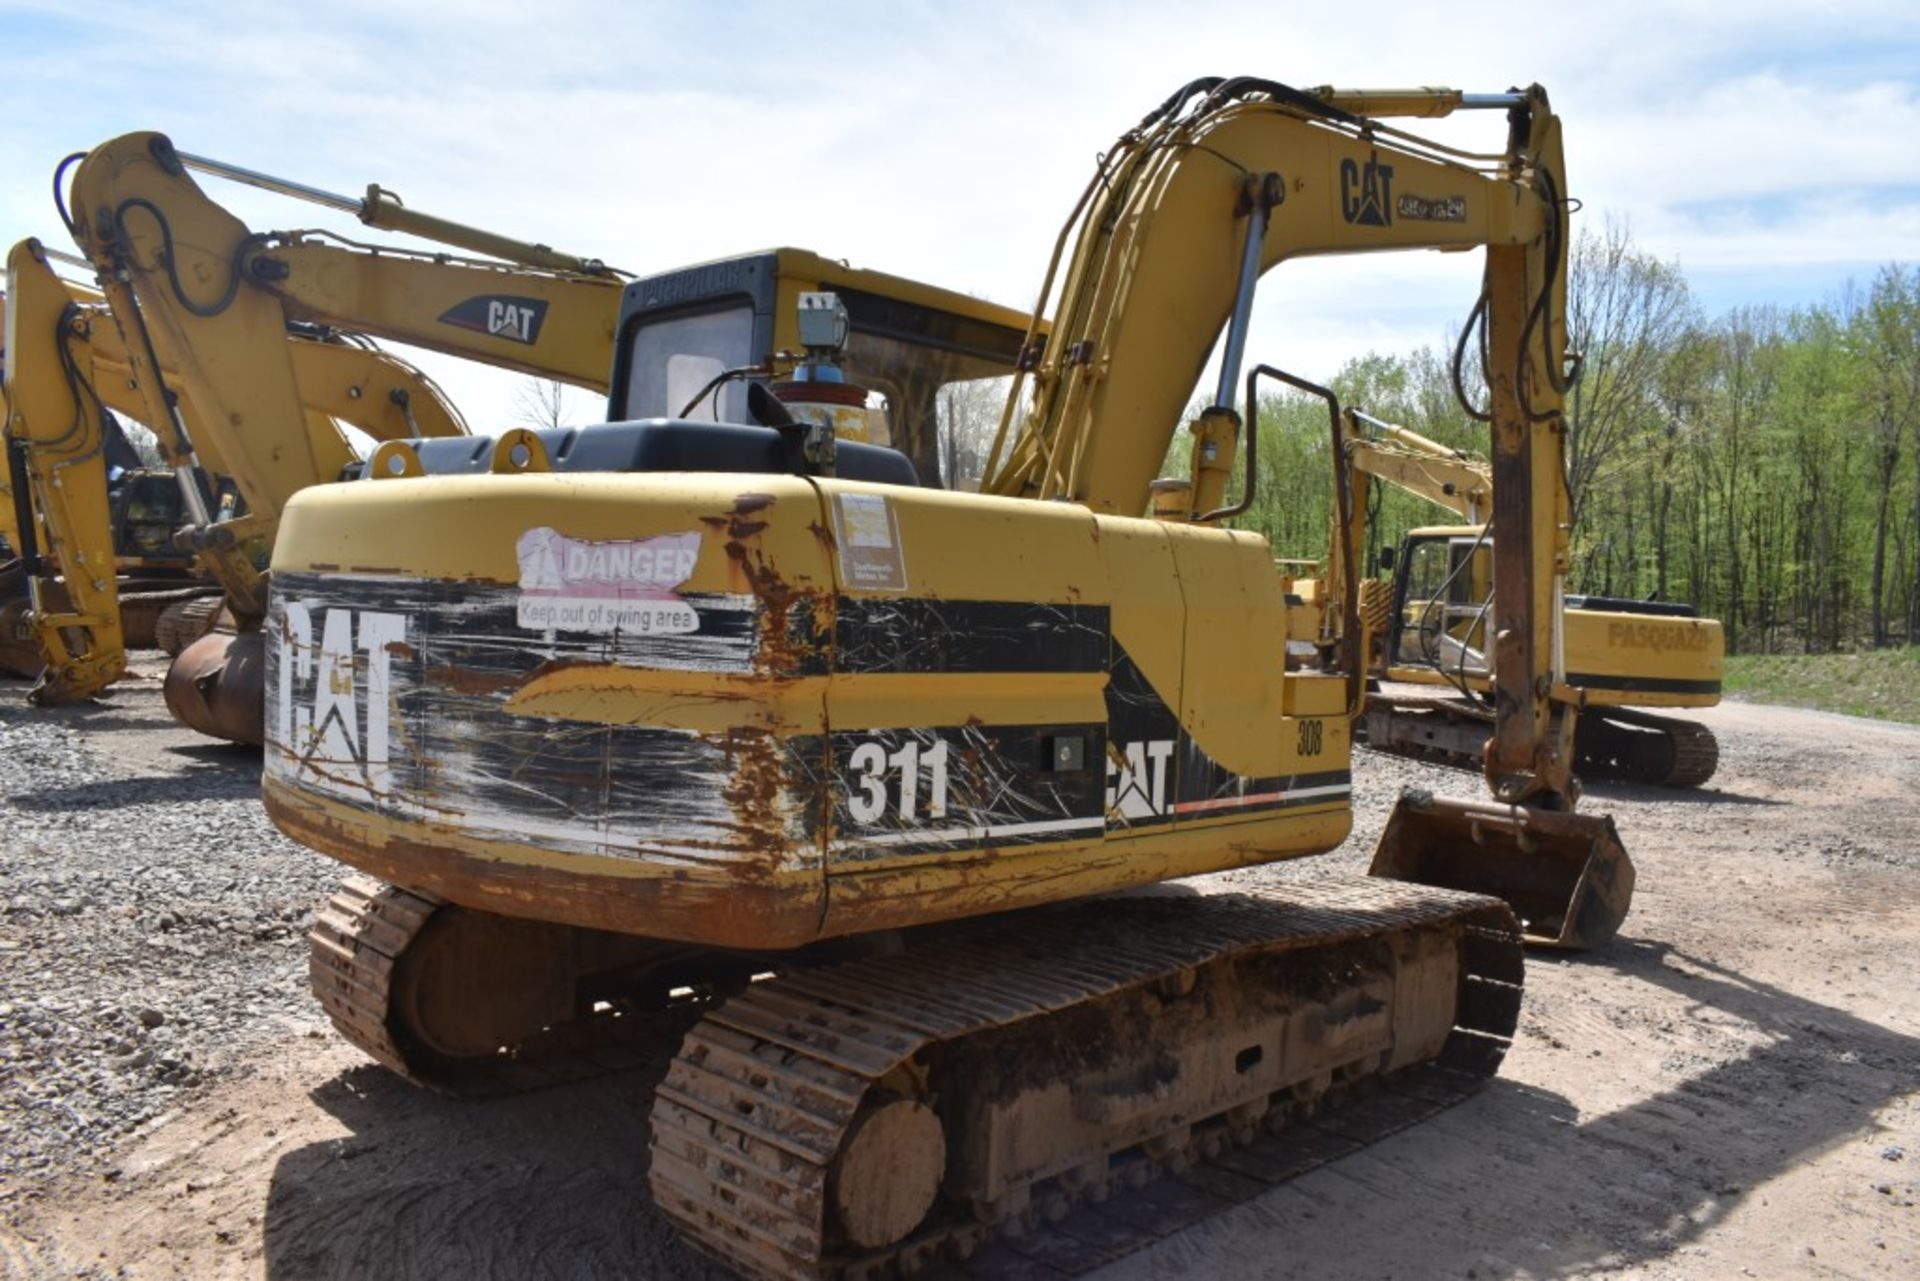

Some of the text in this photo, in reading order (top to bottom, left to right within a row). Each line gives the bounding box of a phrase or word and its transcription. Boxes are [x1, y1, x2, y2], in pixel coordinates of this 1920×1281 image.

[1340, 157, 1394, 227] CAT
[487, 300, 535, 342] CAT
[520, 601, 692, 632] Keep out of swing area
[1297, 720, 1323, 757] 308
[850, 740, 949, 824] 311
